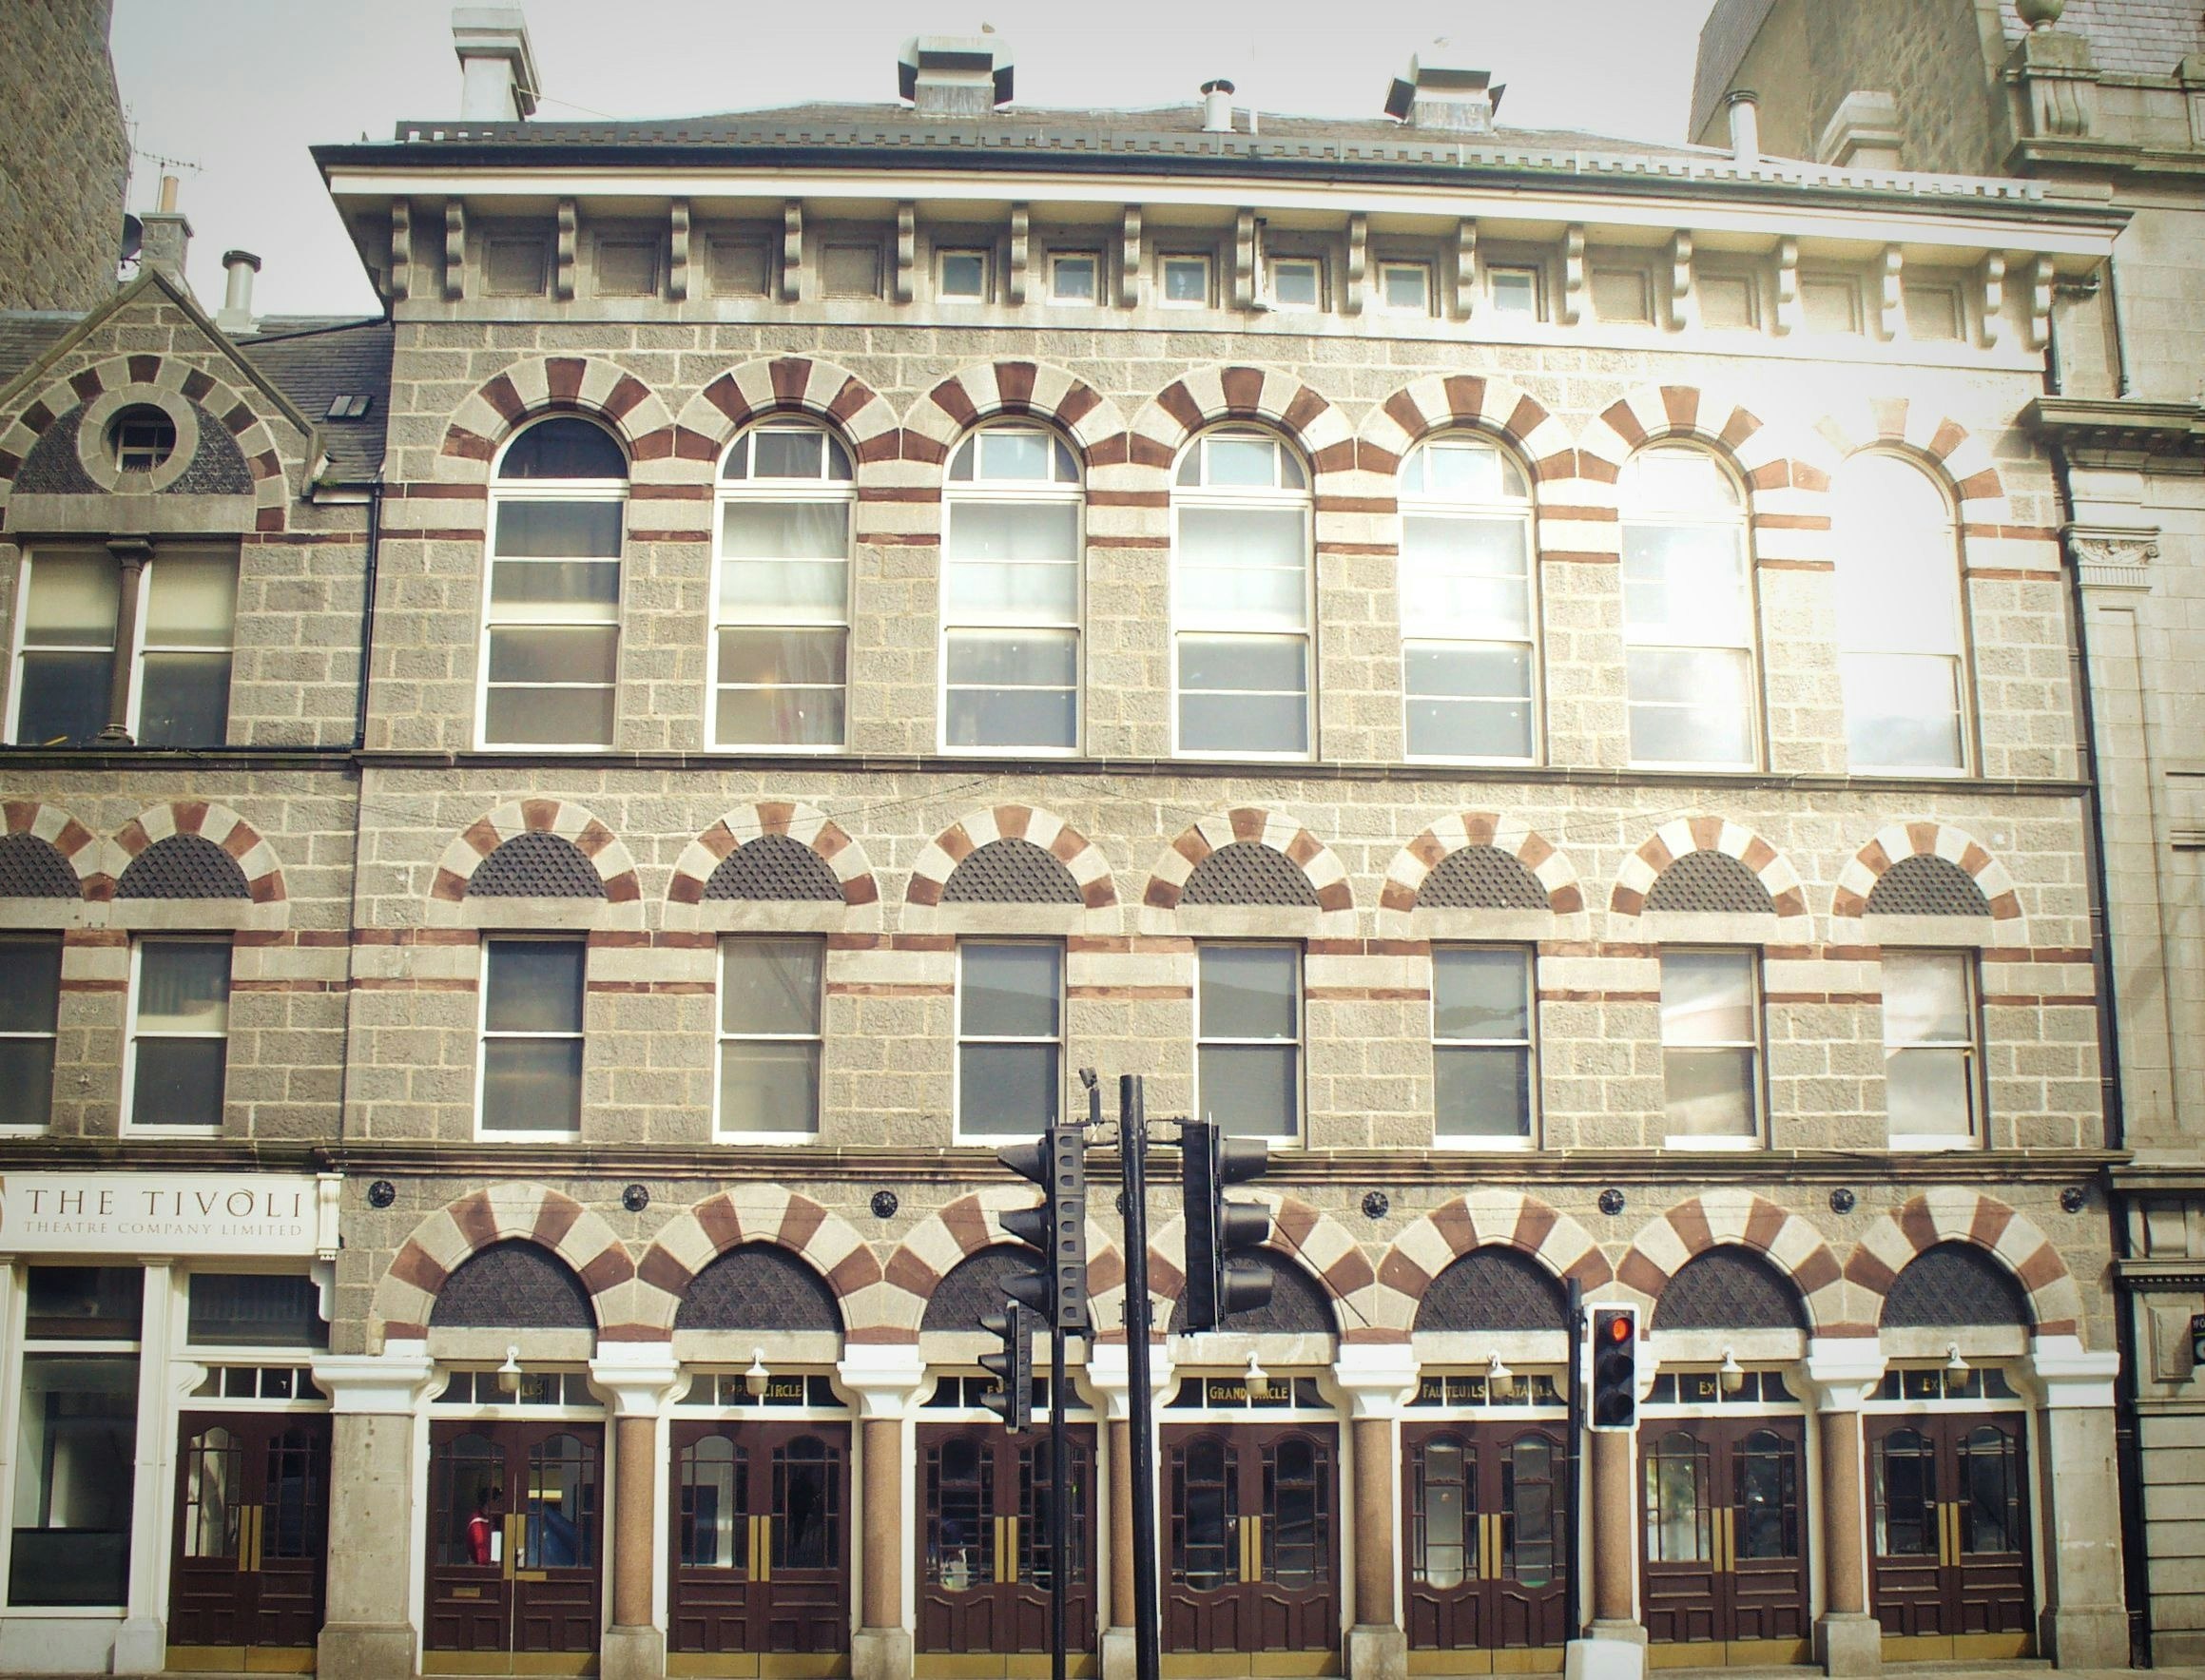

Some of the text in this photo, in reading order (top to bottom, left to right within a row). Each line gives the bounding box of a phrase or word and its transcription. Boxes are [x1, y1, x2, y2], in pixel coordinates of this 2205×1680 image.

[26, 1188, 301, 1218] THE TIVOLI
[25, 1221, 302, 1236] THEATRE COMPANY LIMITED
[764, 1383, 803, 1398] CIRCLE
[1209, 1385, 1289, 1400] GRAND CLE
[1422, 1383, 1486, 1400] FAUTEUILS
